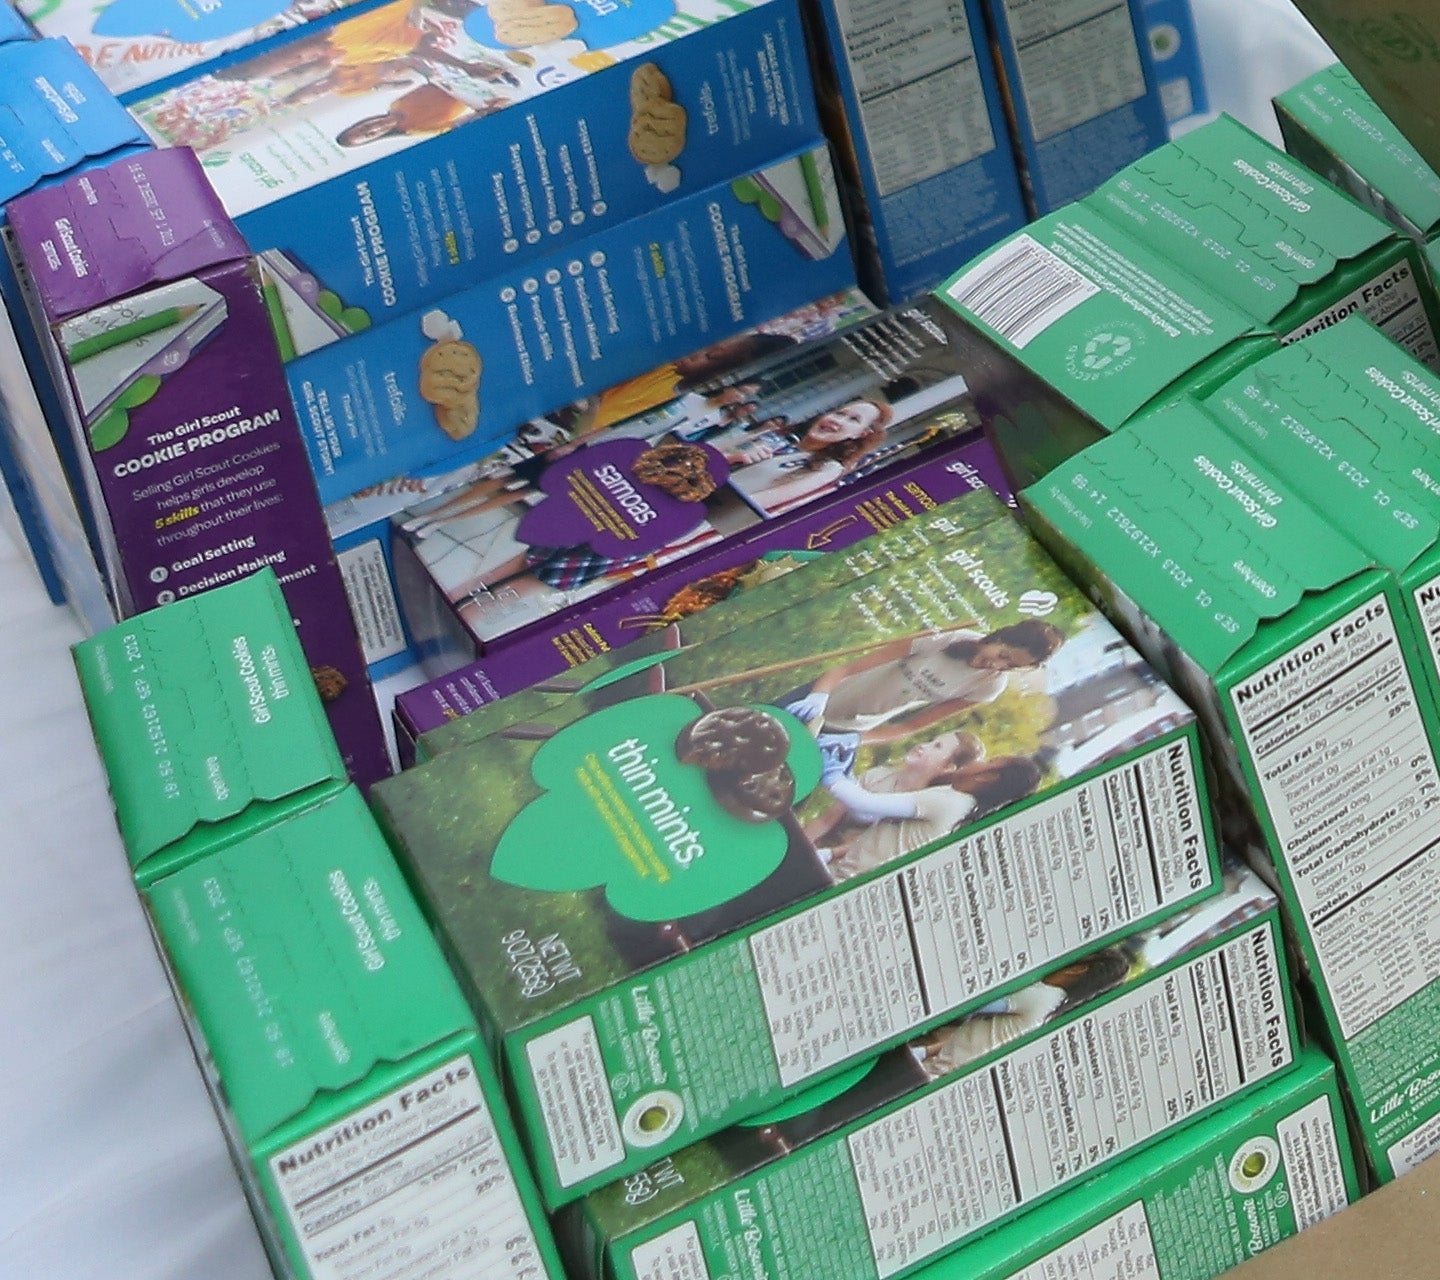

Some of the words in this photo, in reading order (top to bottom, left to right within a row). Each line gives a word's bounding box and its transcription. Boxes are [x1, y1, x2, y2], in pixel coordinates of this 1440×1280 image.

[1229, 157, 1272, 186] Cookies
[1263, 161, 1296, 183] mints
[1287, 177, 1315, 195] thin
[1262, 180, 1296, 202] Scout
[1286, 196, 1313, 214] Girl
[356, 179, 386, 257] PROGRAM
[707, 201, 729, 255] COOKIE
[718, 254, 745, 322] PROGRAM
[374, 253, 397, 308] COOKIE
[1362, 266, 1410, 303] Facts
[1360, 365, 1407, 401] Cookies
[1400, 372, 1436, 398] mints
[317, 389, 331, 416] TELL
[1398, 393, 1434, 421] Scout
[146, 428, 174, 446] The
[174, 418, 201, 437] Girl
[200, 404, 241, 428] Scout
[324, 414, 334, 430] US
[113, 441, 186, 478] COOKIE
[186, 408, 281, 453] PROGRAM
[327, 429, 342, 458] YOUR
[132, 478, 174, 503] Selling
[172, 470, 195, 486] Girl
[194, 458, 230, 478] Scout
[231, 440, 280, 465] Cookies
[157, 491, 191, 511] helps
[190, 481, 216, 500] girls
[216, 464, 265, 490] develop
[1188, 453, 1236, 490] Cookies
[1227, 461, 1264, 489] mints
[154, 517, 165, 529] 5
[164, 503, 200, 525] skills
[200, 494, 225, 512] that
[226, 484, 255, 504] they
[253, 477, 276, 492] use
[594, 464, 658, 526] samoas
[1223, 484, 1262, 513] Scout
[1253, 484, 1284, 507] thin
[156, 514, 225, 548] throughout
[224, 503, 253, 521] their
[253, 491, 284, 511] lives:
[1249, 508, 1280, 529] Girl
[171, 552, 204, 573] Goal
[204, 533, 256, 563] Setting
[941, 545, 985, 573] girl
[964, 567, 1016, 609] scouts
[228, 634, 257, 676] Cookies
[256, 646, 283, 678] mints
[1236, 636, 1325, 706] Nutrition
[1329, 598, 1385, 646] Facts
[240, 673, 266, 705] Scout
[267, 675, 290, 699] thin
[250, 702, 272, 724] Girl
[603, 734, 670, 793] thin
[634, 781, 719, 866] mints
[1166, 742, 1194, 832] Nutrition
[1183, 833, 1203, 890] Facts
[1284, 804, 1350, 852] Cholesterol
[1295, 854, 1325, 879] Total
[1322, 806, 1399, 861] Carbohydrate
[1307, 888, 1351, 921] Protein
[499, 927, 527, 945] 9
[504, 936, 536, 962] OZ
[535, 932, 571, 965] NET
[507, 953, 557, 1001] (255g)
[549, 956, 582, 986] WT
[1250, 927, 1276, 1013] Nutrition
[1266, 1013, 1284, 1069] Facts
[277, 1104, 393, 1177] Nutrition
[398, 1062, 471, 1112] Facts
